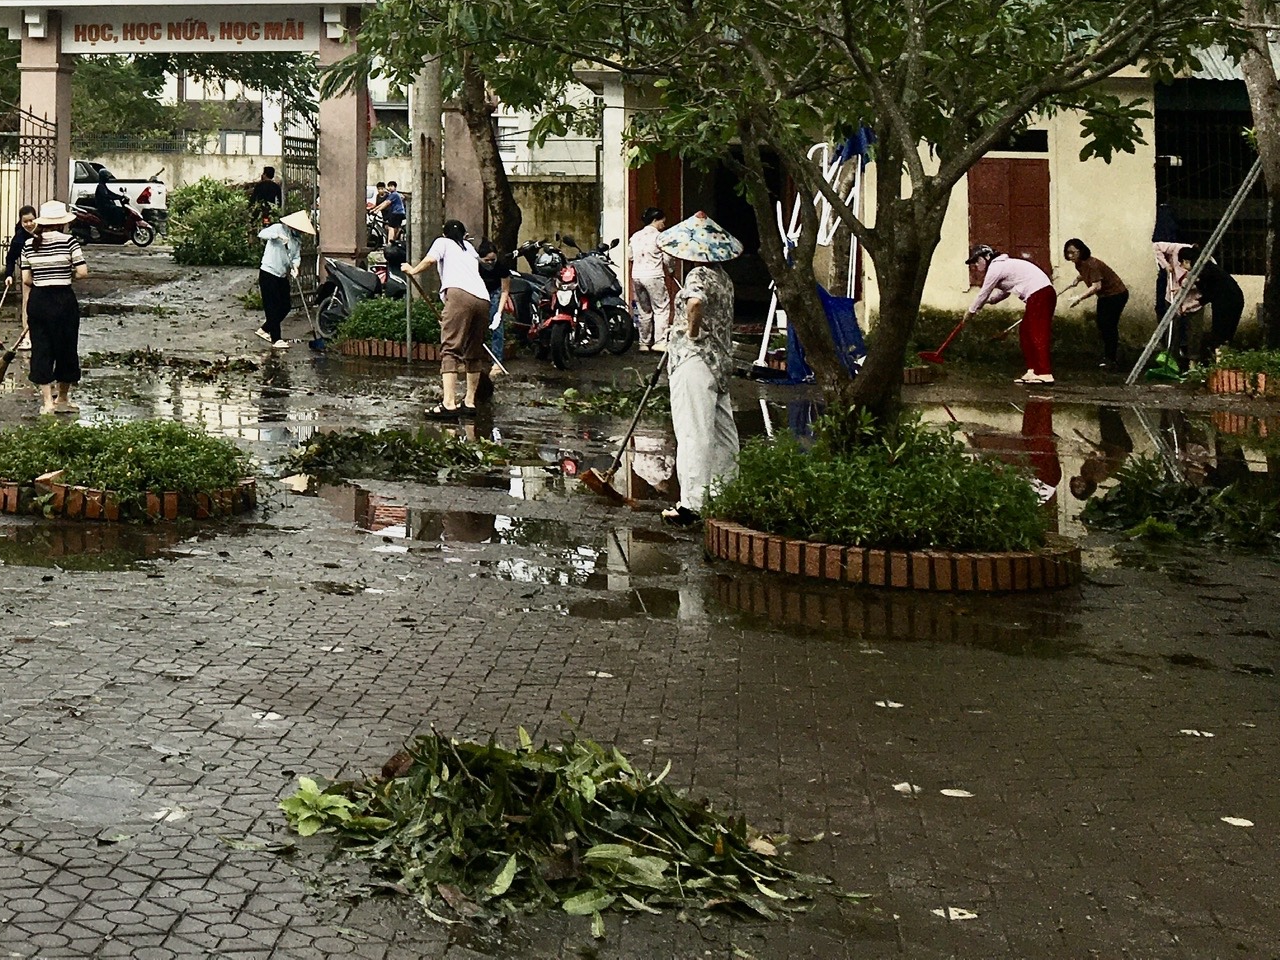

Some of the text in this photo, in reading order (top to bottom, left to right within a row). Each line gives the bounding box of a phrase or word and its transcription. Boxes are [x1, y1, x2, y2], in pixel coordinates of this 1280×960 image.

[74, 17, 304, 46] HỌC, HỌC NỮA, HỌC MÃI
